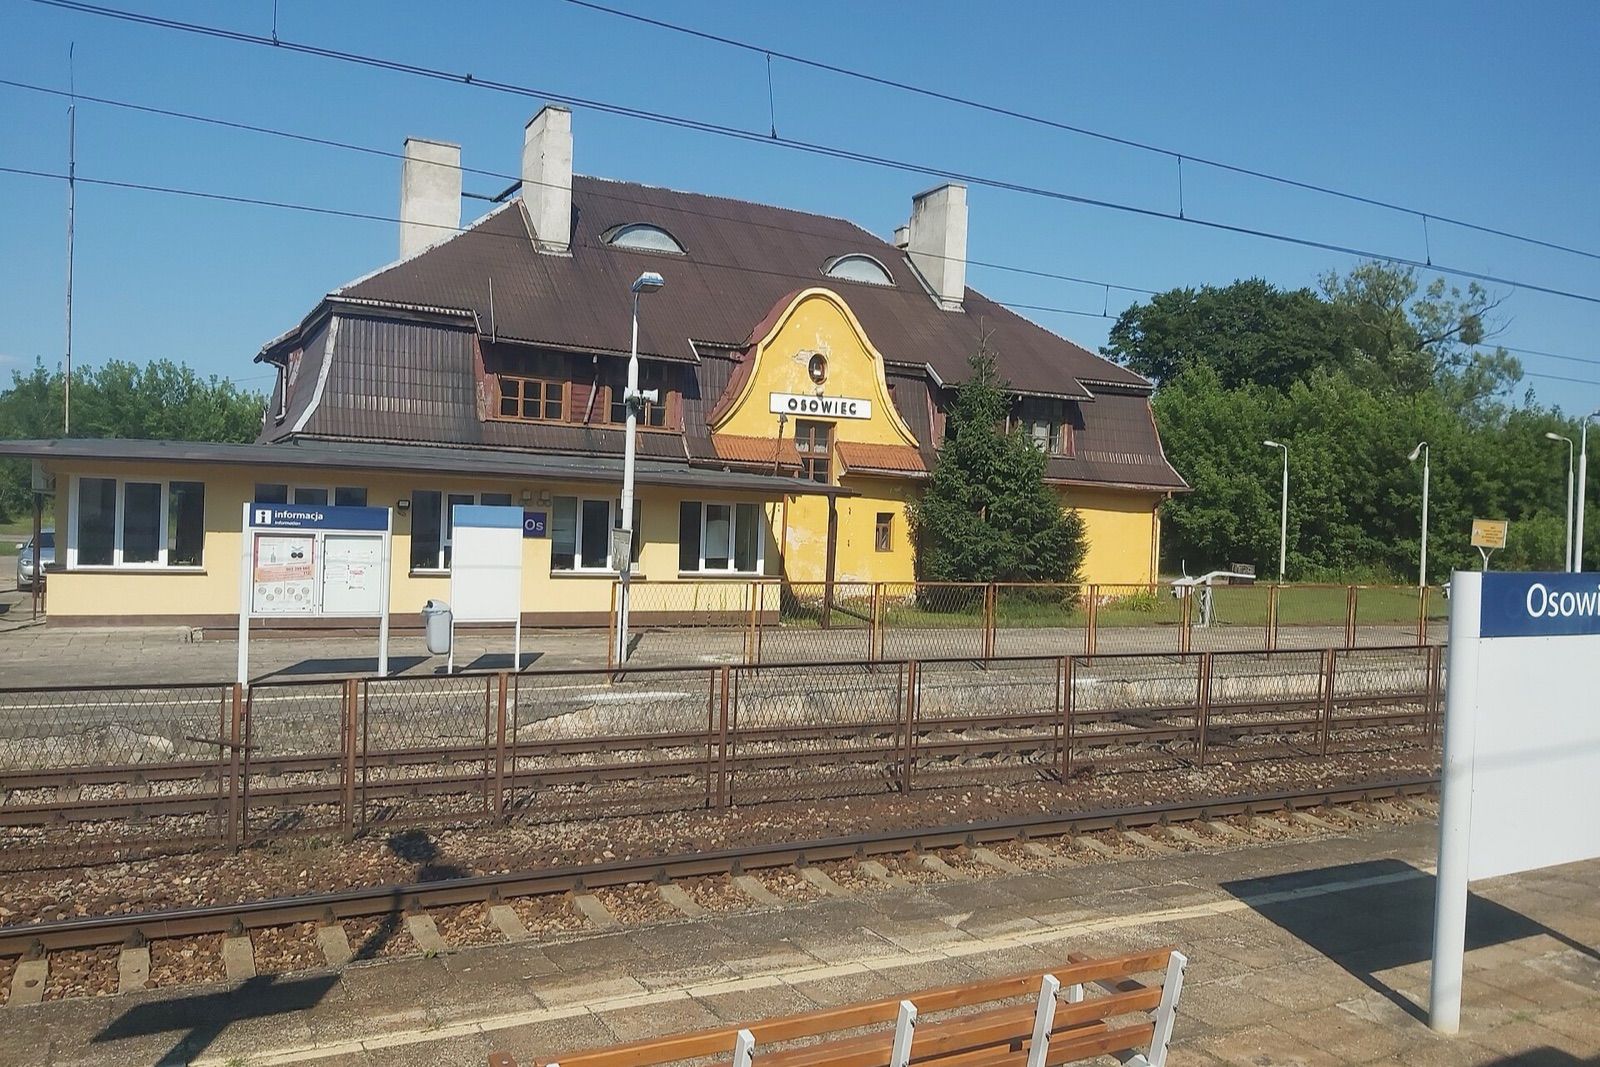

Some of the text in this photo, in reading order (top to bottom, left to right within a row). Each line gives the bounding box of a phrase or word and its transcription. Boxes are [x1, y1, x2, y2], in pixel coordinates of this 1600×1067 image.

[788, 398, 857, 415] OSOWIEC
[274, 510, 324, 522] informacja
[524, 518, 544, 531] Os
